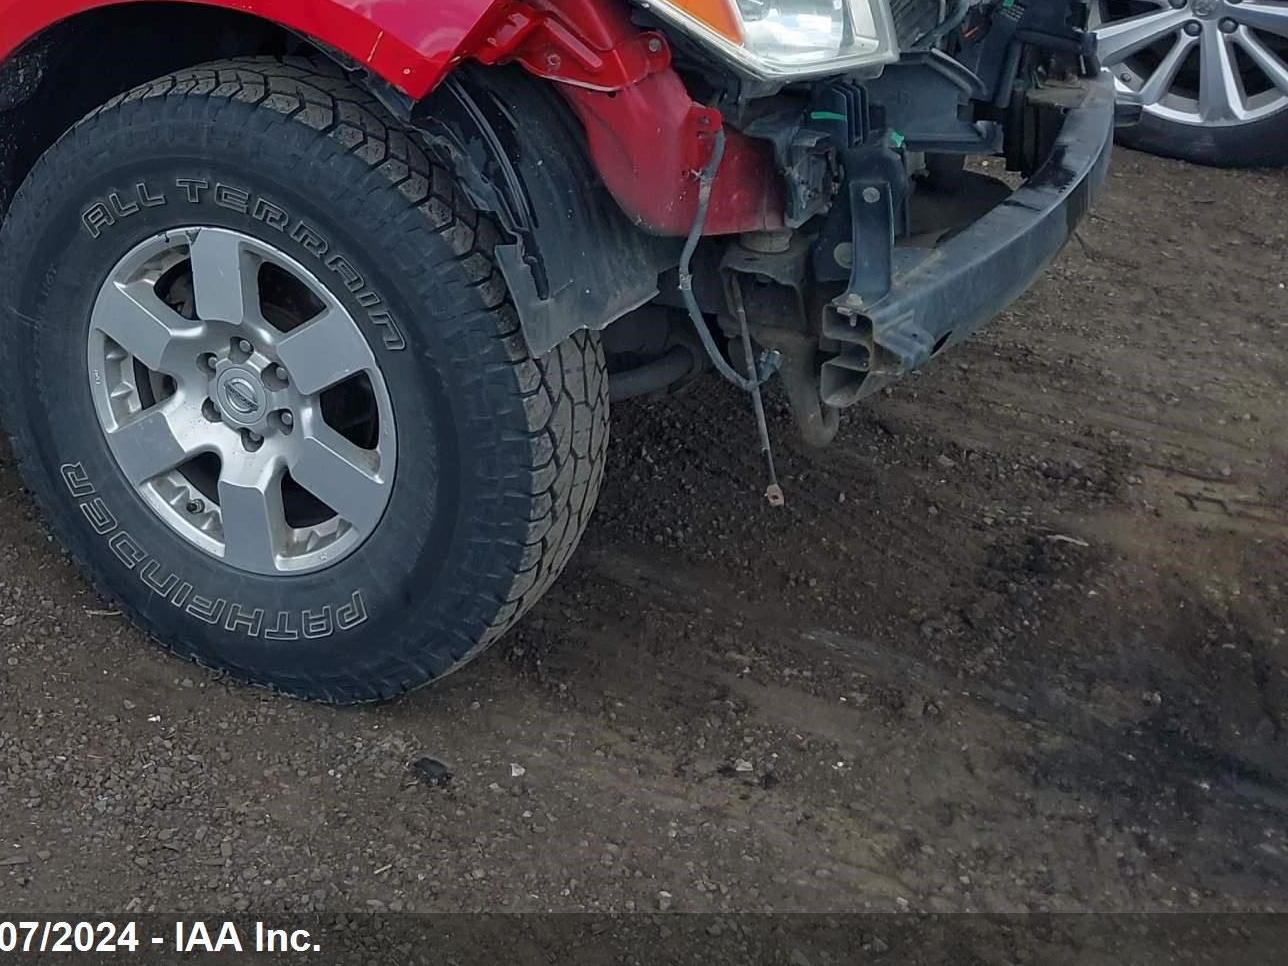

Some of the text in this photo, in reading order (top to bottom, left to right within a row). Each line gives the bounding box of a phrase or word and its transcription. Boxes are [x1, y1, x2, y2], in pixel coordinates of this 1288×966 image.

[81, 178, 407, 351] ALL TERRAIN
[60, 461, 369, 641] PATHFINDER
